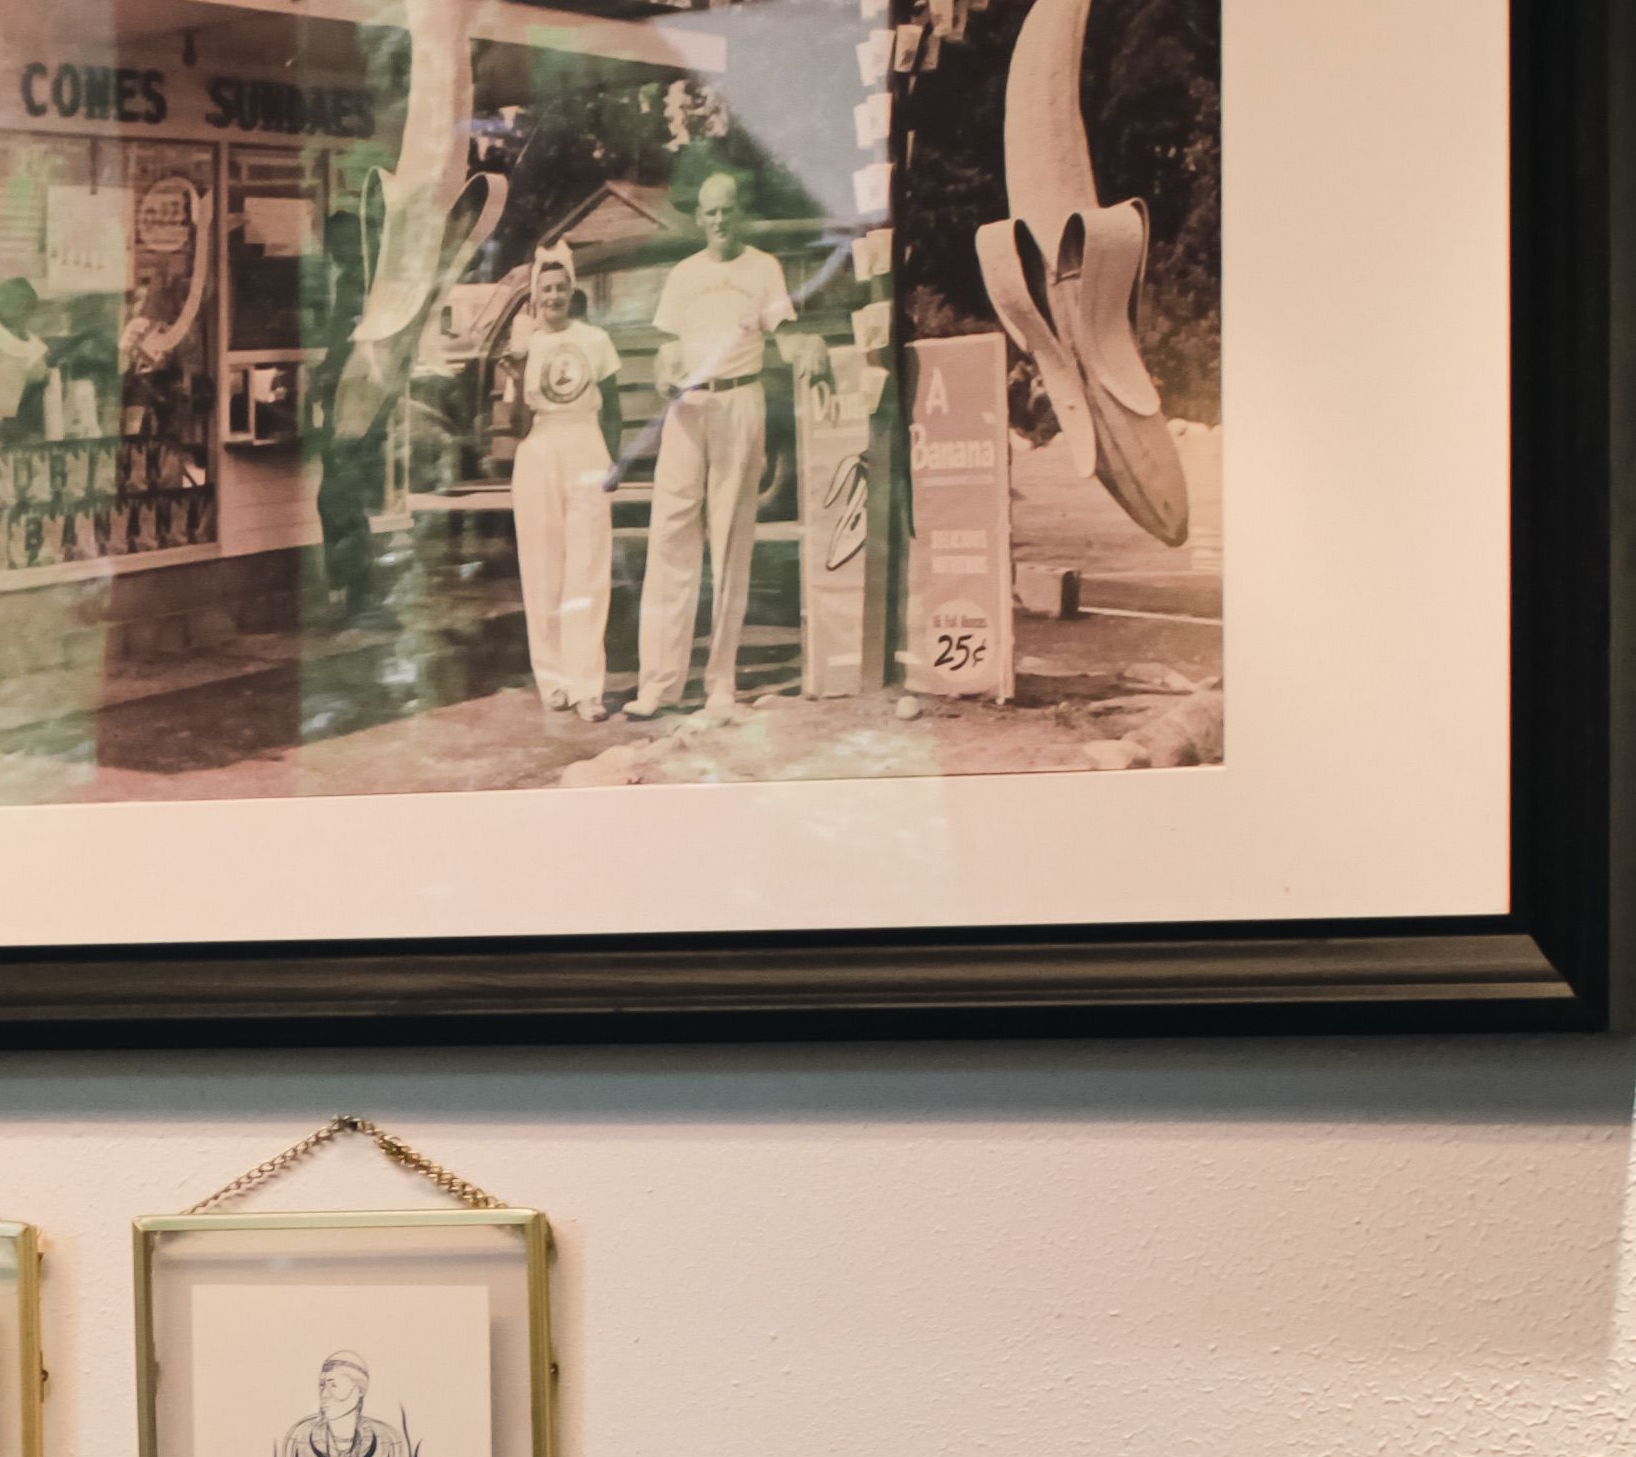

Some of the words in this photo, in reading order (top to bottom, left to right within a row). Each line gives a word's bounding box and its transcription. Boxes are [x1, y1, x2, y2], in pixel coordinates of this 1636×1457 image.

[20, 62, 167, 125] CONES
[924, 367, 949, 415] A
[909, 423, 994, 470] Banana
